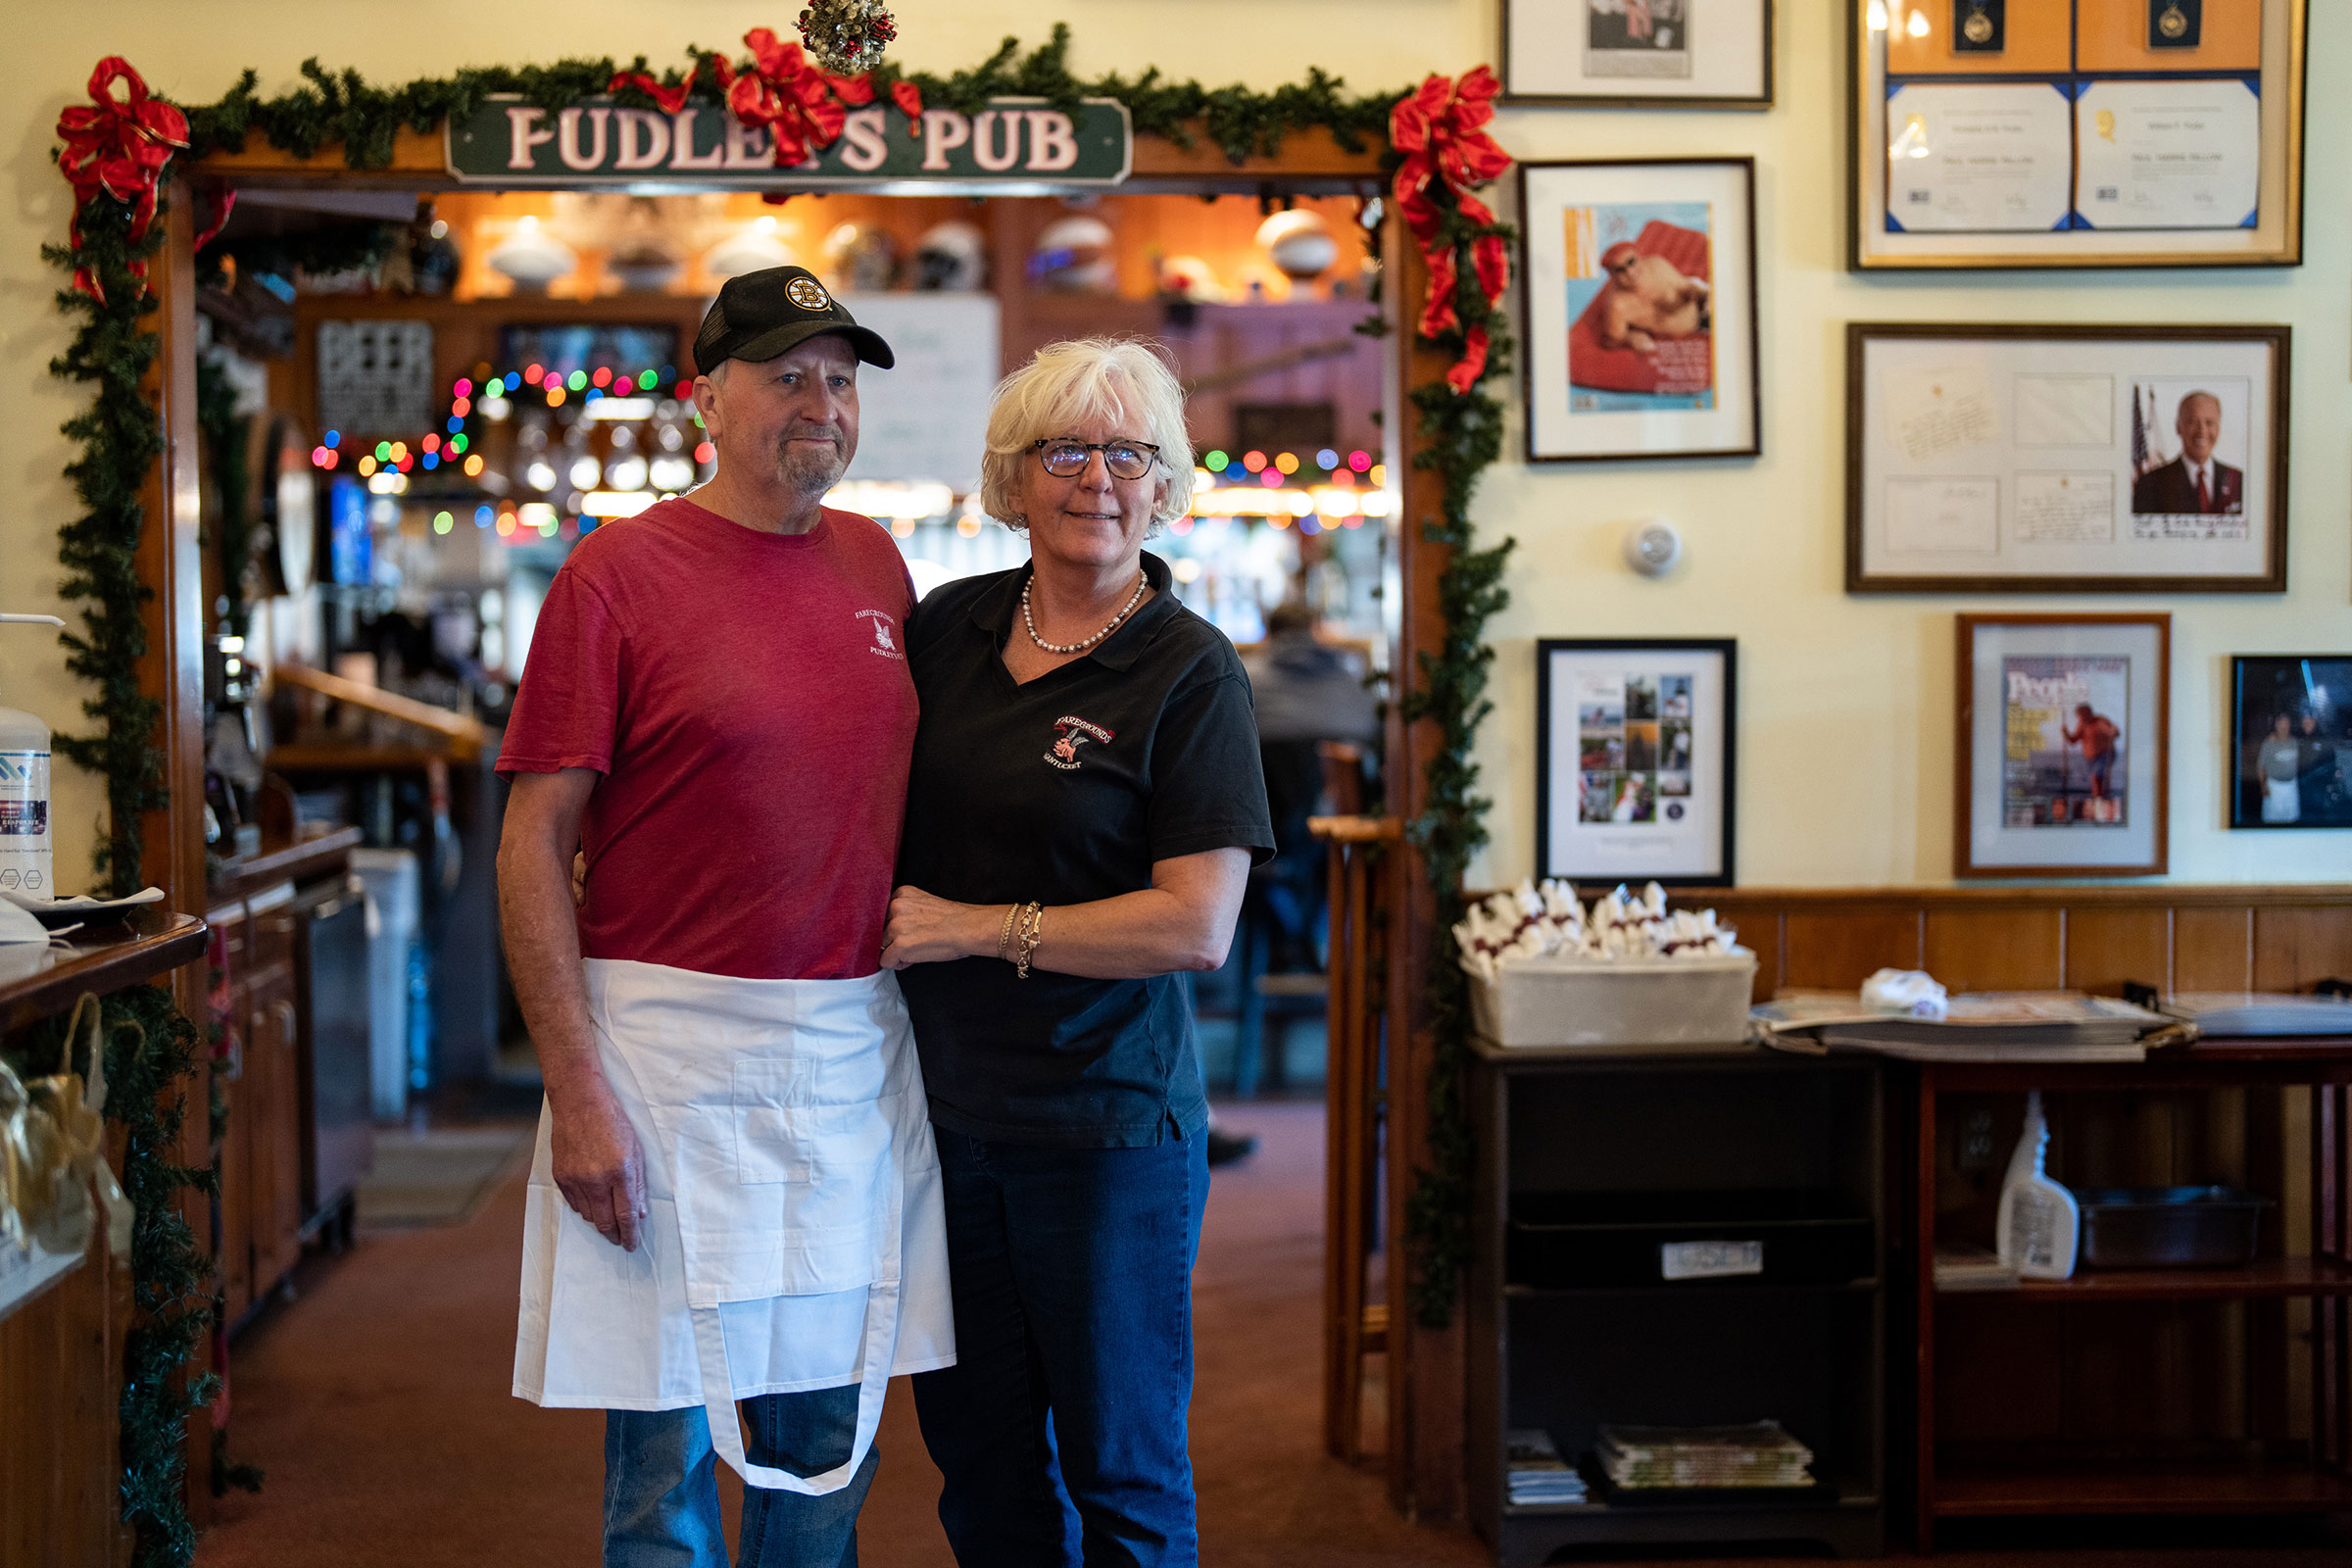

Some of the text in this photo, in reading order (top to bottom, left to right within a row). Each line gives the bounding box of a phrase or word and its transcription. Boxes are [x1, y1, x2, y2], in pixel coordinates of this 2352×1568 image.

[921, 110, 1079, 172] PUB
[796, 283, 820, 303] B
[1054, 715, 1113, 744] FAREGROUNDS
